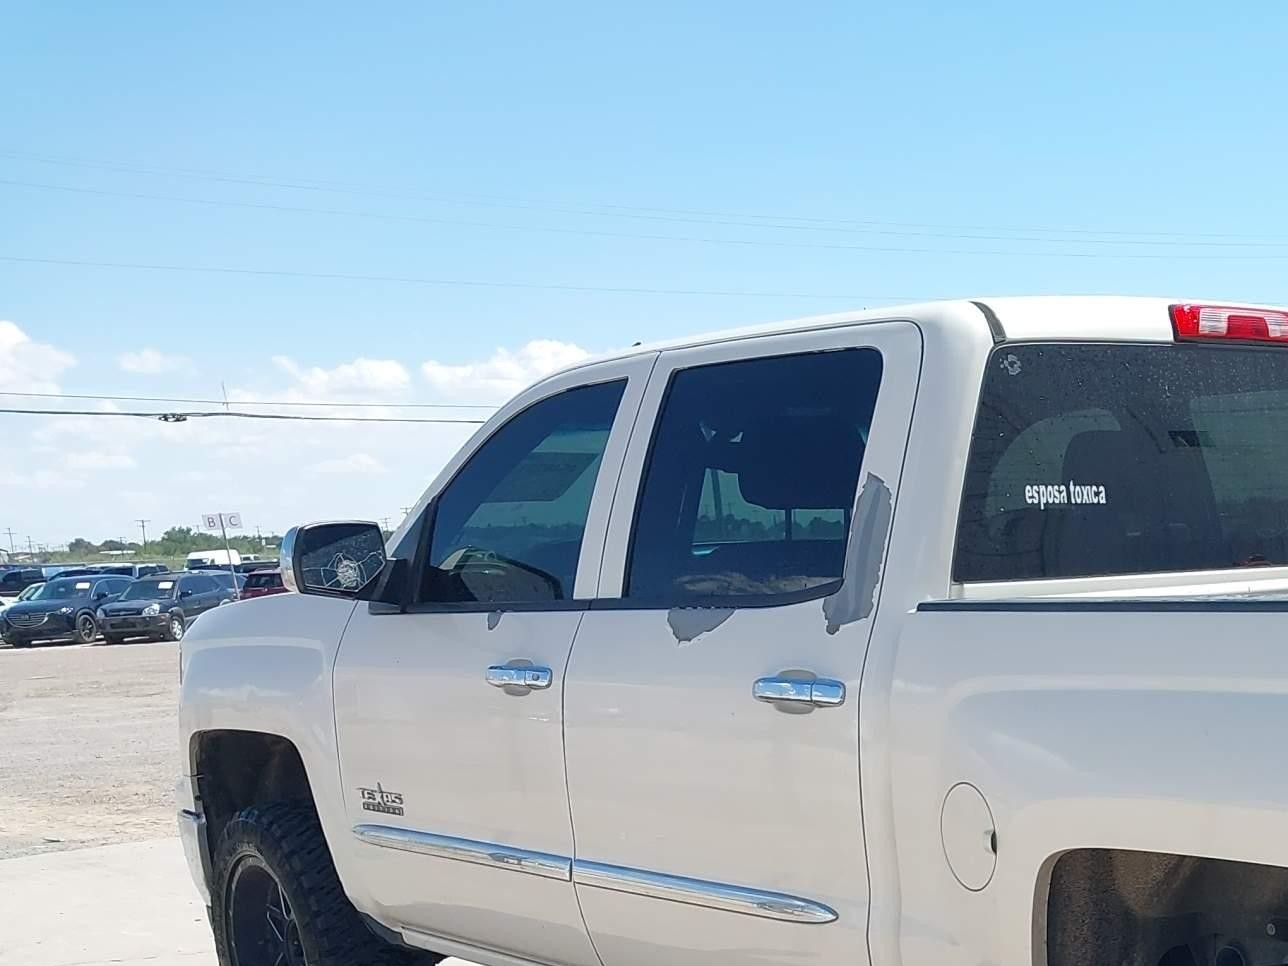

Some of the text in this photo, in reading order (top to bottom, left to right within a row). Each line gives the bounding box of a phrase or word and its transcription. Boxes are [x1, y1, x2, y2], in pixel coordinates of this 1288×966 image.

[1025, 484, 1068, 510] esposa
[207, 516, 216, 528] B
[229, 515, 238, 527] C
